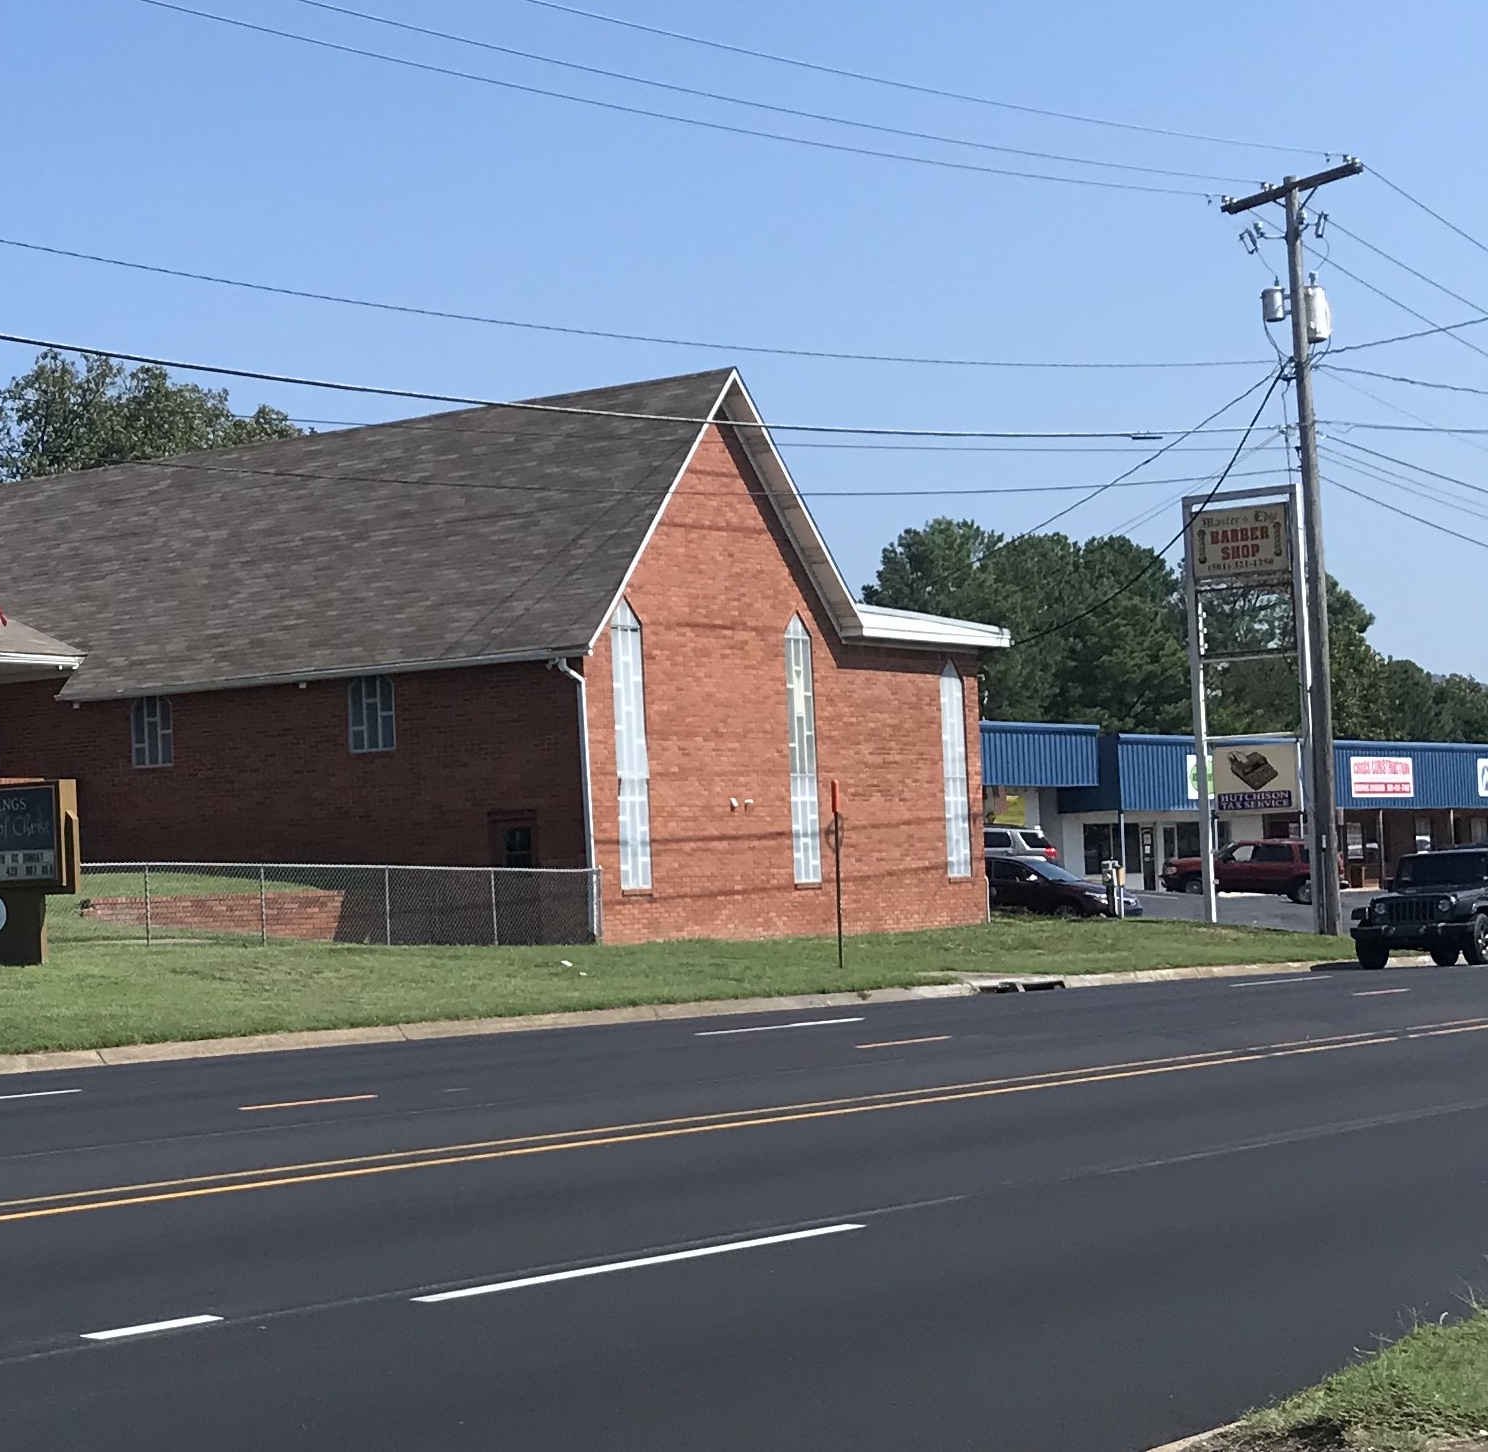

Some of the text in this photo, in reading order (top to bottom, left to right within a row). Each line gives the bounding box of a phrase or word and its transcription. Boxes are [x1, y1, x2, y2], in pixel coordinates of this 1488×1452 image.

[1211, 526, 1269, 544] BARBER
[1221, 544, 1259, 560] SHOP
[1221, 792, 1288, 802] HUTCHISON
[1222, 800, 1289, 810] TAX SERVICE
[12, 812, 50, 837] Christ
